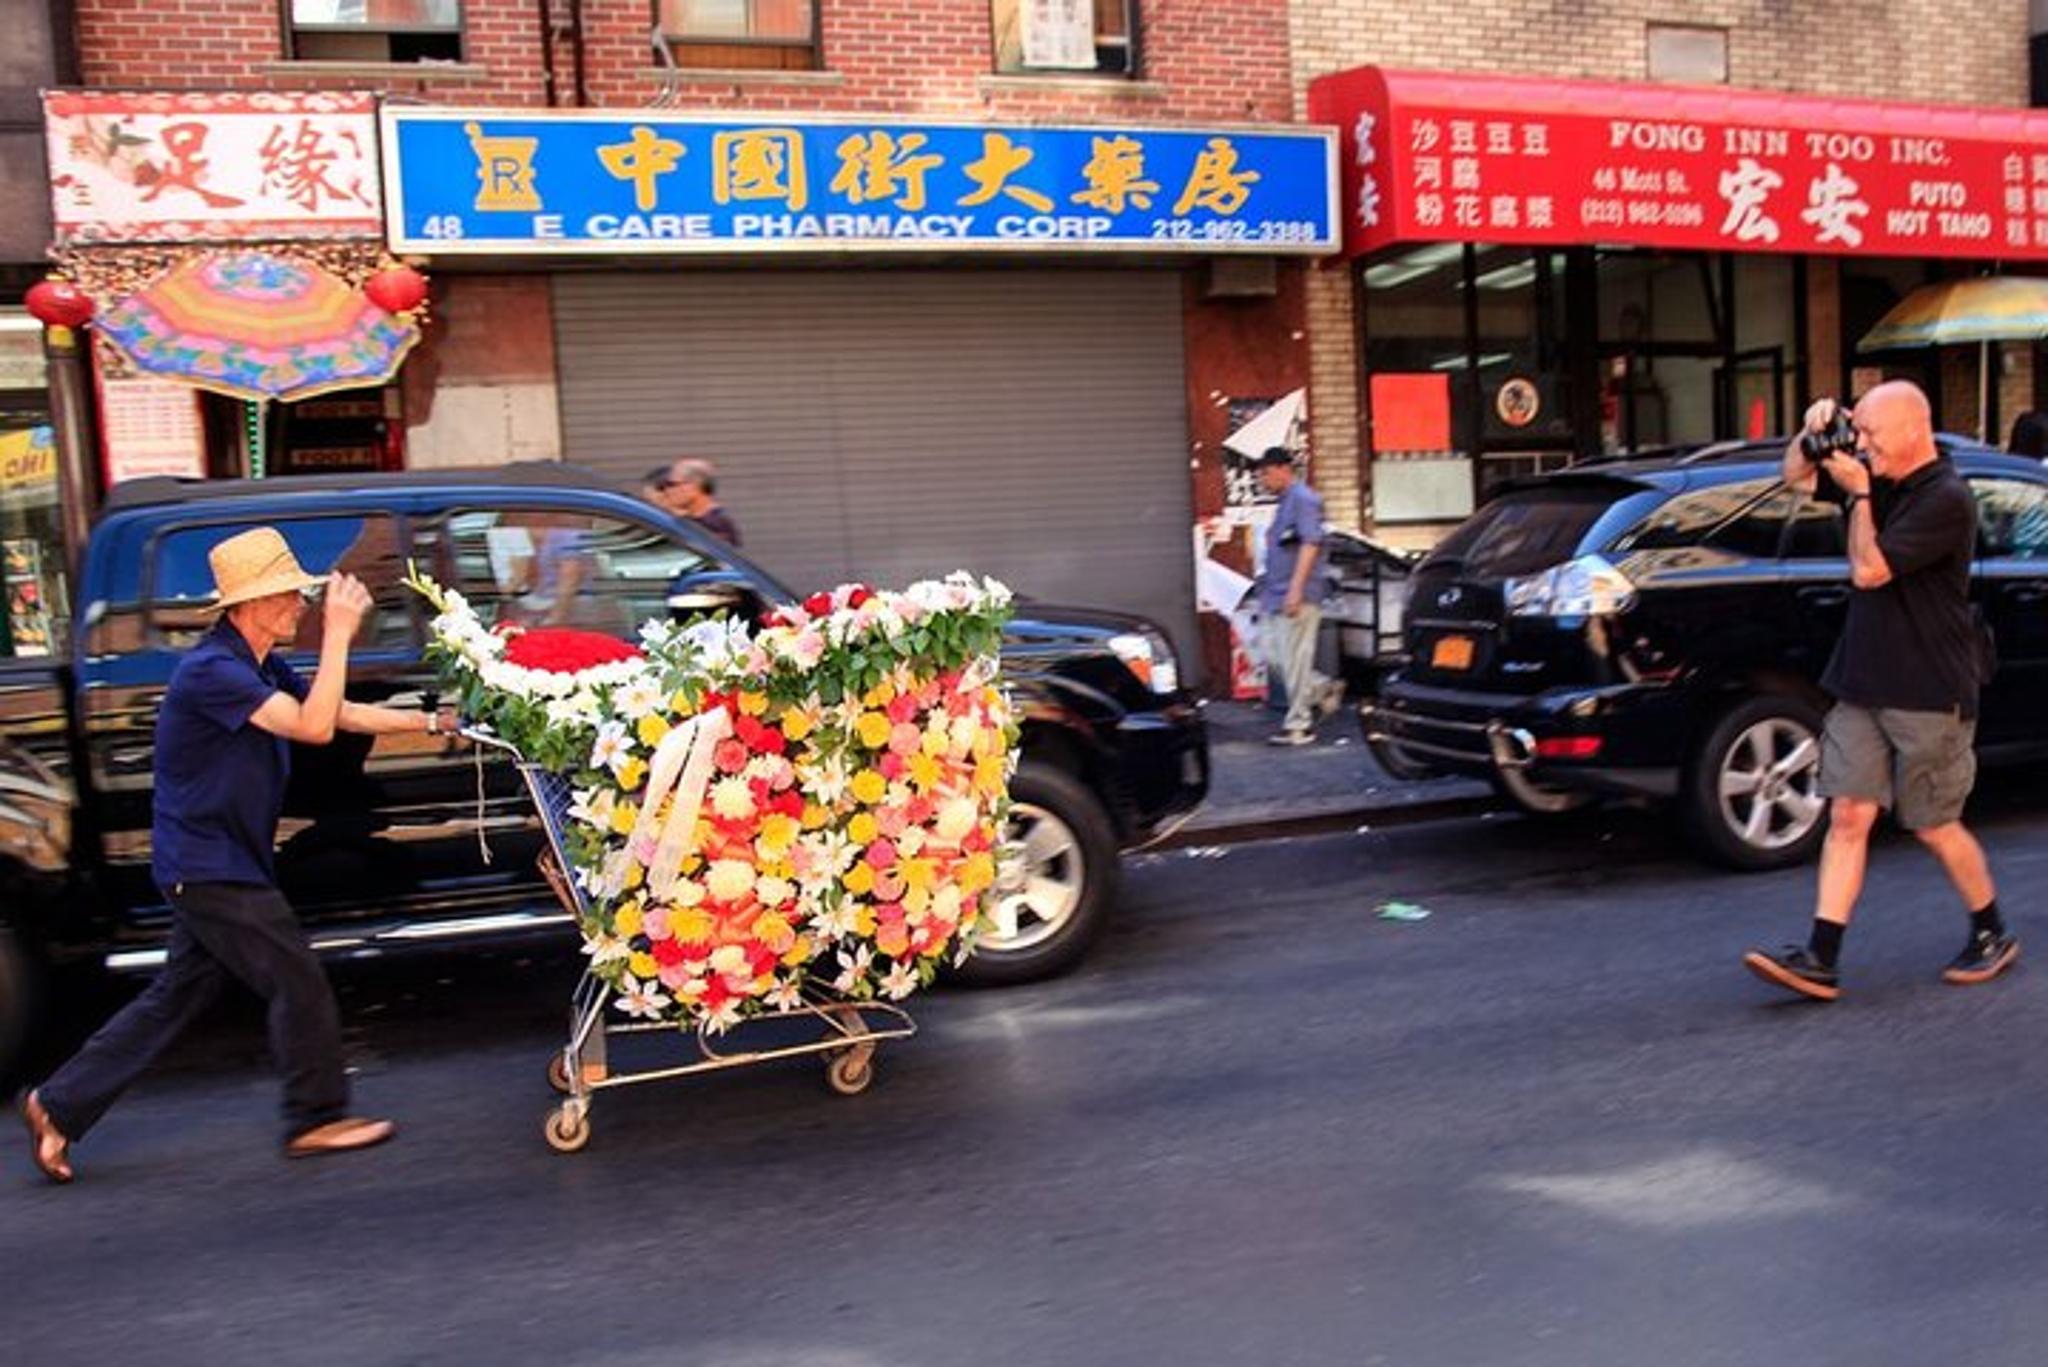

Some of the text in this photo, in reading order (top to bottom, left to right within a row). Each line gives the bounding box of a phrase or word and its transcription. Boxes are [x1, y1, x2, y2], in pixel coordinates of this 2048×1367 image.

[1609, 120, 1952, 167] FONG INN TOO INC.
[1718, 158, 1869, 247] 宏安
[1909, 180, 1967, 208] PUTO
[422, 215, 465, 239] 48
[533, 214, 1112, 239] E CARE PHARMACY CORP
[1887, 210, 1931, 236] HOT
